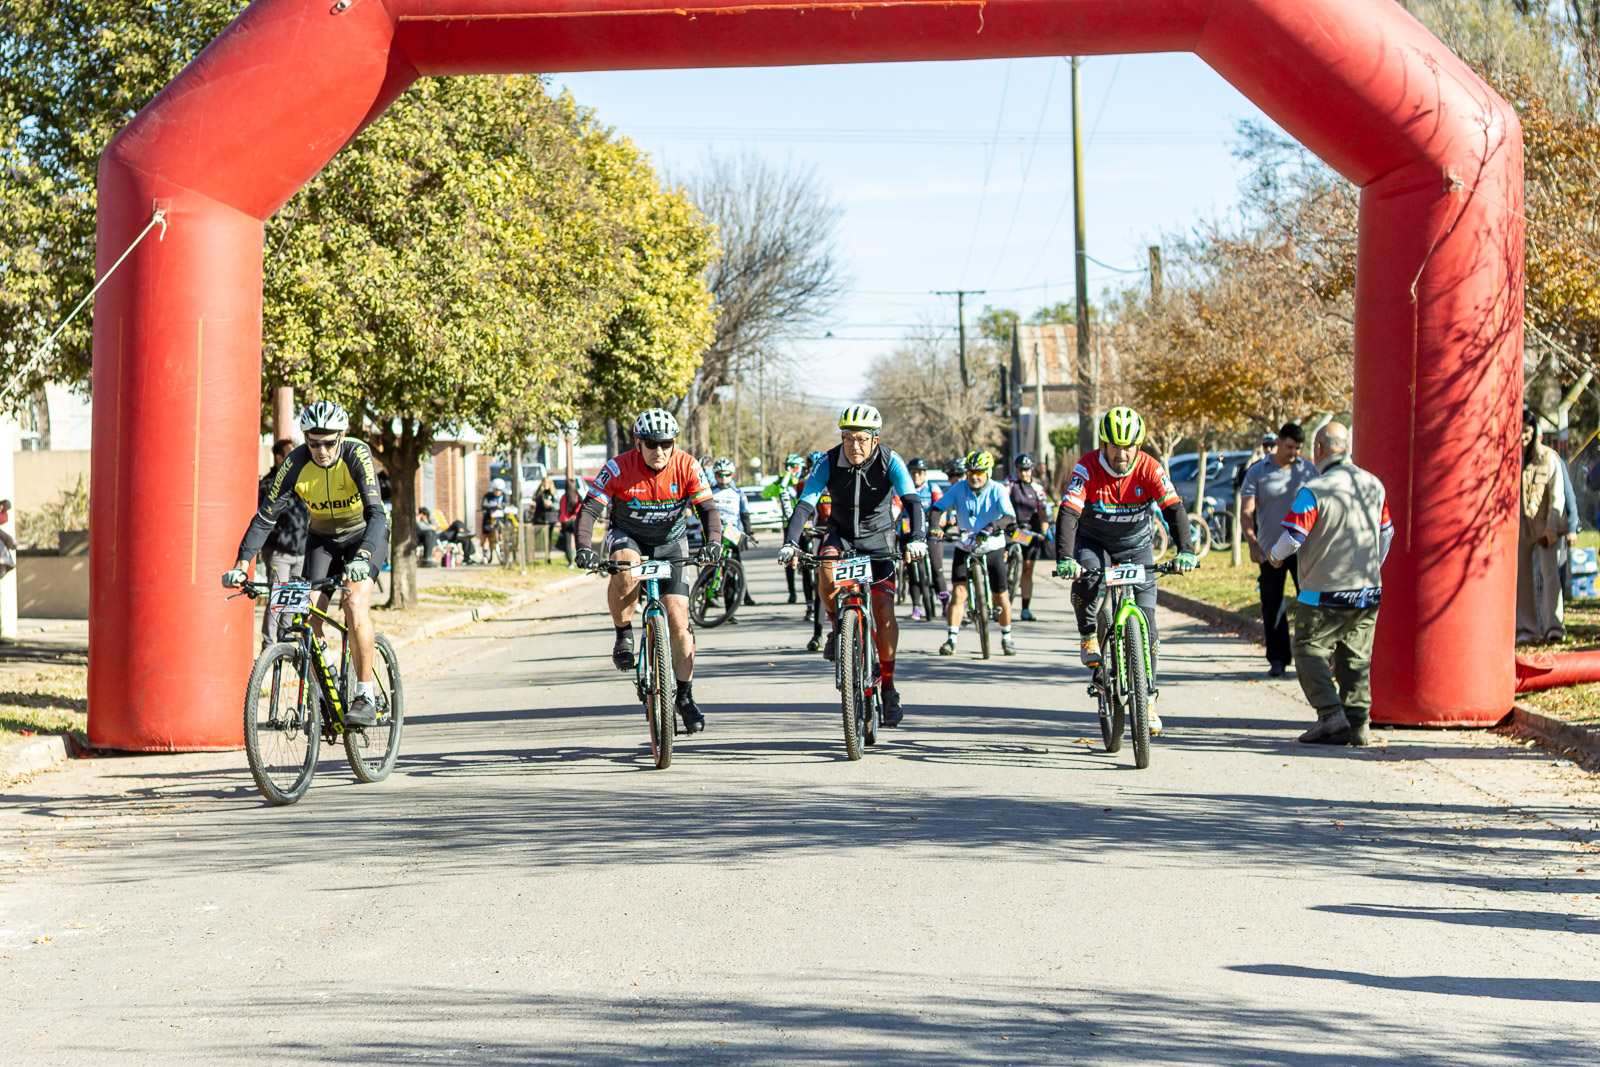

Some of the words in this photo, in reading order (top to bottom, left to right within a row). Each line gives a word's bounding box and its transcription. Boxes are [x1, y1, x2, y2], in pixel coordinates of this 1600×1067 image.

[353, 445, 376, 486] MAXIBIKE
[268, 456, 293, 503] MAXIBIKE
[640, 565, 660, 576] 13
[835, 563, 867, 581] 213
[1112, 569, 1138, 580] 30
[276, 589, 304, 606] 65
